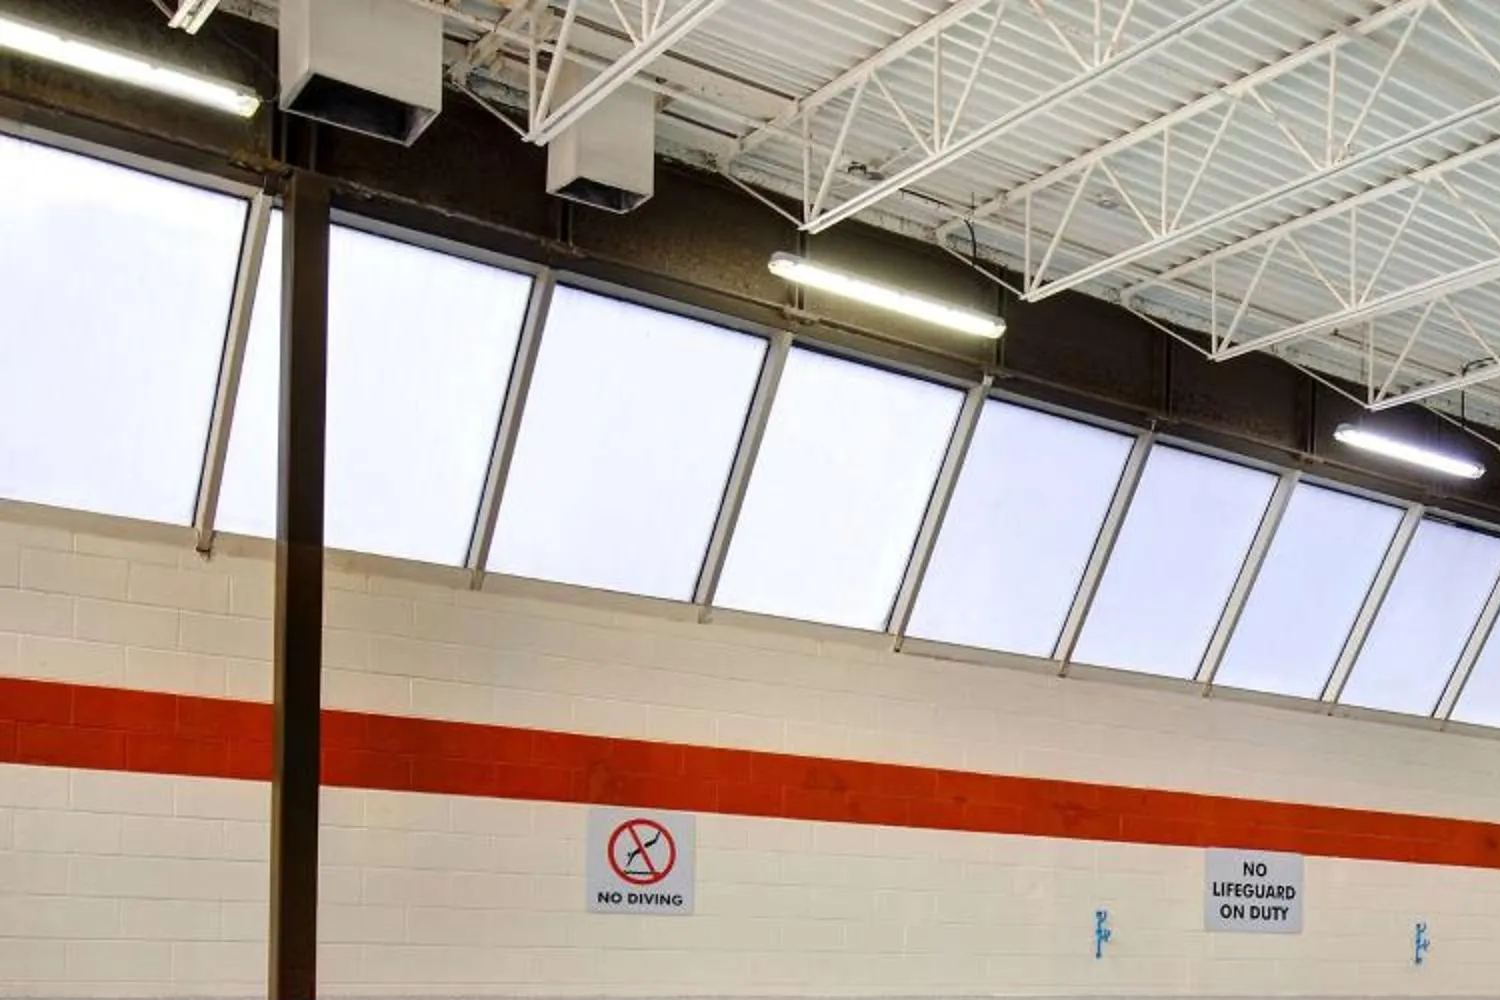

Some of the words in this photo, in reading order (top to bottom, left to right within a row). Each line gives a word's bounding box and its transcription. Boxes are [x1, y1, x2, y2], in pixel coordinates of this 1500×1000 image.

[1243, 862, 1267, 877] NO
[597, 892, 623, 904] NO
[627, 893, 683, 906] DIVING
[1212, 882, 1296, 900] LIFEGUARD
[1220, 904, 1245, 920] ON
[1249, 905, 1289, 921] DUTY
